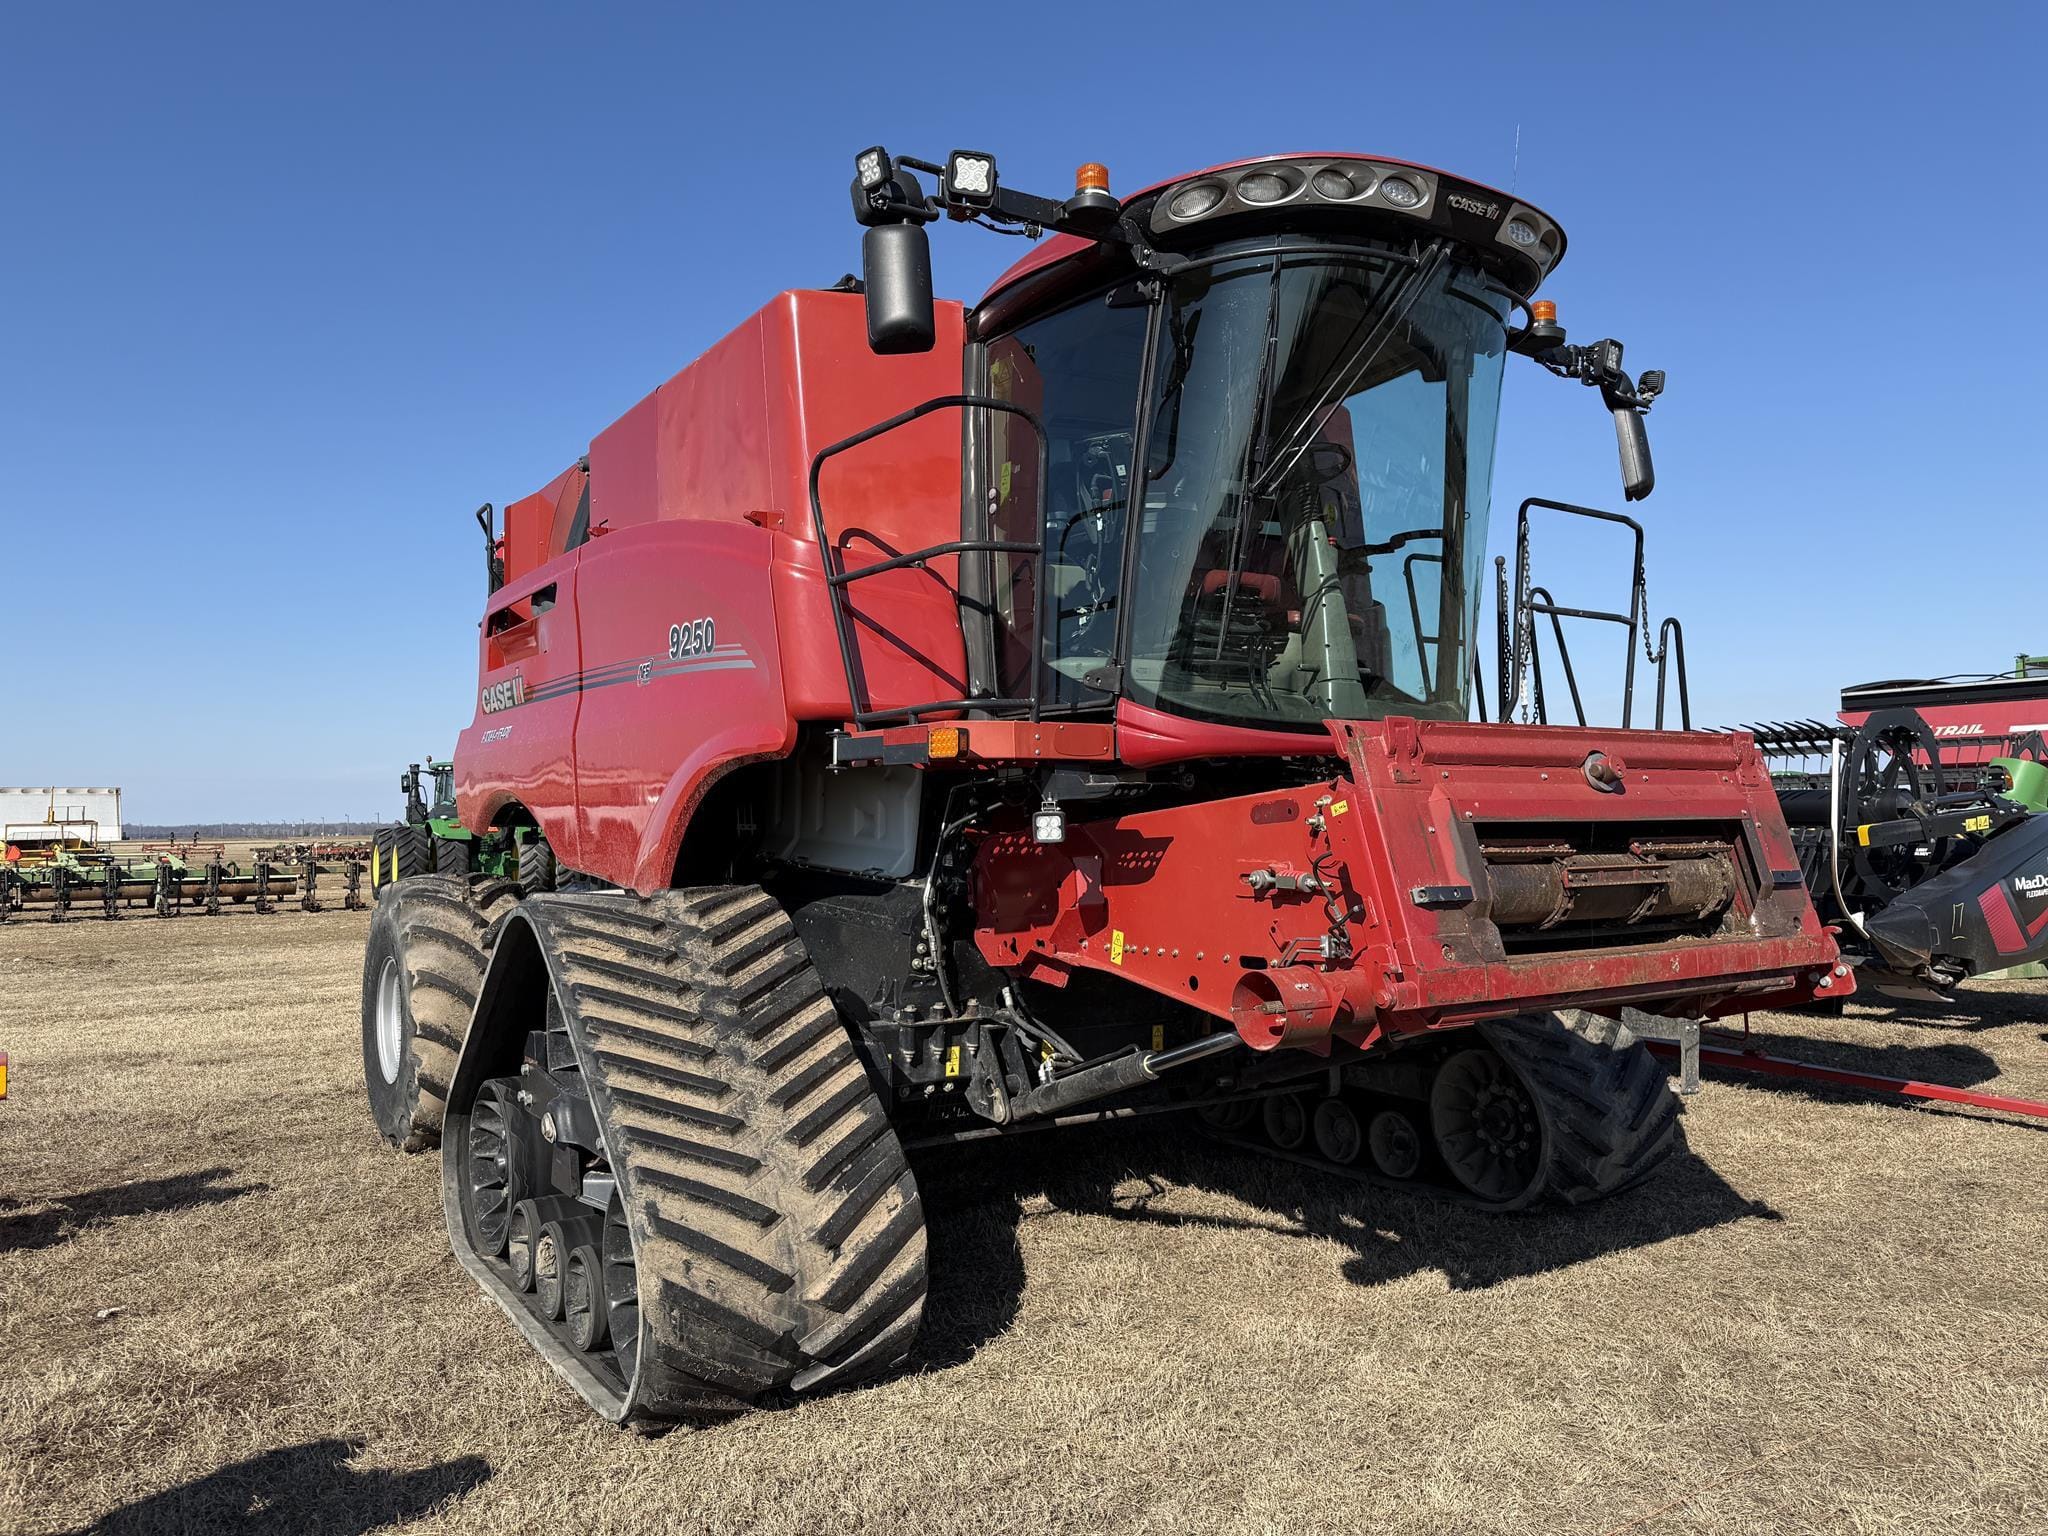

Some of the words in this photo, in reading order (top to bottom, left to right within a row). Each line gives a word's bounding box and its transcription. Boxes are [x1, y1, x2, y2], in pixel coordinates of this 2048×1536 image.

[1451, 196, 1487, 216] CASE
[669, 617, 715, 660] 9250
[482, 681, 513, 714] CASE
[1934, 723, 1985, 737] TRAIL
